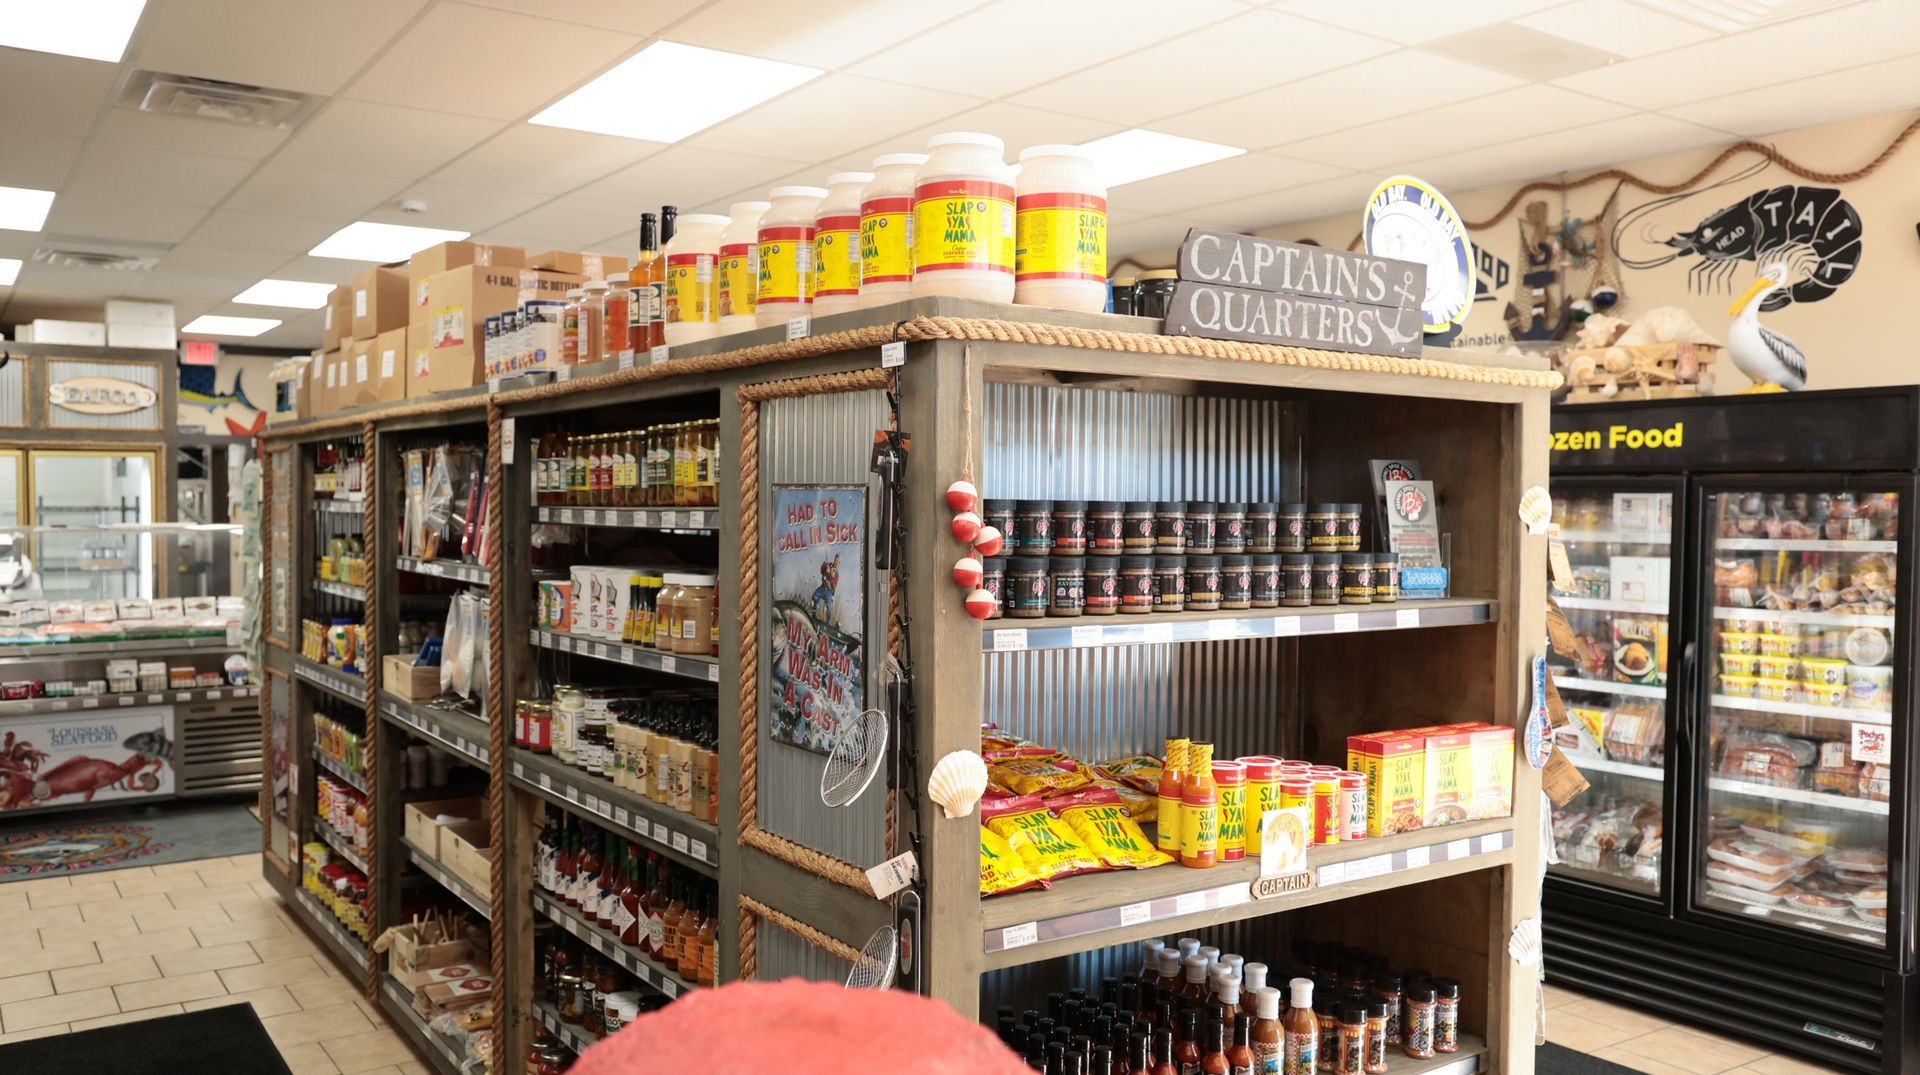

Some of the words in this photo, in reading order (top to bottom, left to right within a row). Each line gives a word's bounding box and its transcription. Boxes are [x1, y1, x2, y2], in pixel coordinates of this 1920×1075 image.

[946, 202, 974, 215] SLAP
[952, 216, 965, 229] YA
[1078, 214, 1099, 228] SLAP
[944, 229, 976, 243] MAMA
[1716, 225, 1745, 250] HEAD
[1077, 240, 1101, 256] MAMA
[1190, 233, 1387, 302] CAPTAIN'S
[500, 276, 516, 287] GAL.
[1190, 287, 1374, 347] QUARTERS
[49, 383, 157, 408] SEAFOOD
[1609, 422, 1683, 448] Food
[787, 503, 814, 526] HAD
[820, 497, 838, 520] TO
[778, 532, 808, 552] CALL
[809, 527, 823, 546] IN
[826, 520, 858, 545] SICK
[787, 617, 810, 651] MY
[817, 635, 850, 677] ARM
[787, 652, 822, 693] WAS
[827, 676, 843, 706] IN
[783, 681, 796, 711] A
[801, 691, 840, 738] CAST
[50, 734, 118, 747] SEAFOOD
[1395, 757, 1412, 772] SLAP
[1260, 786, 1279, 802] SLA
[1394, 784, 1413, 797] MAMA
[1014, 812, 1049, 830] SLAP
[1084, 807, 1119, 822] SLAP
[1033, 827, 1054, 845] YA
[1103, 820, 1121, 838] YA
[1218, 823, 1246, 840] MAM
[1035, 840, 1079, 856] MAMA
[1103, 836, 1142, 852] MAMA
[1261, 873, 1308, 895] CAPTAIN
